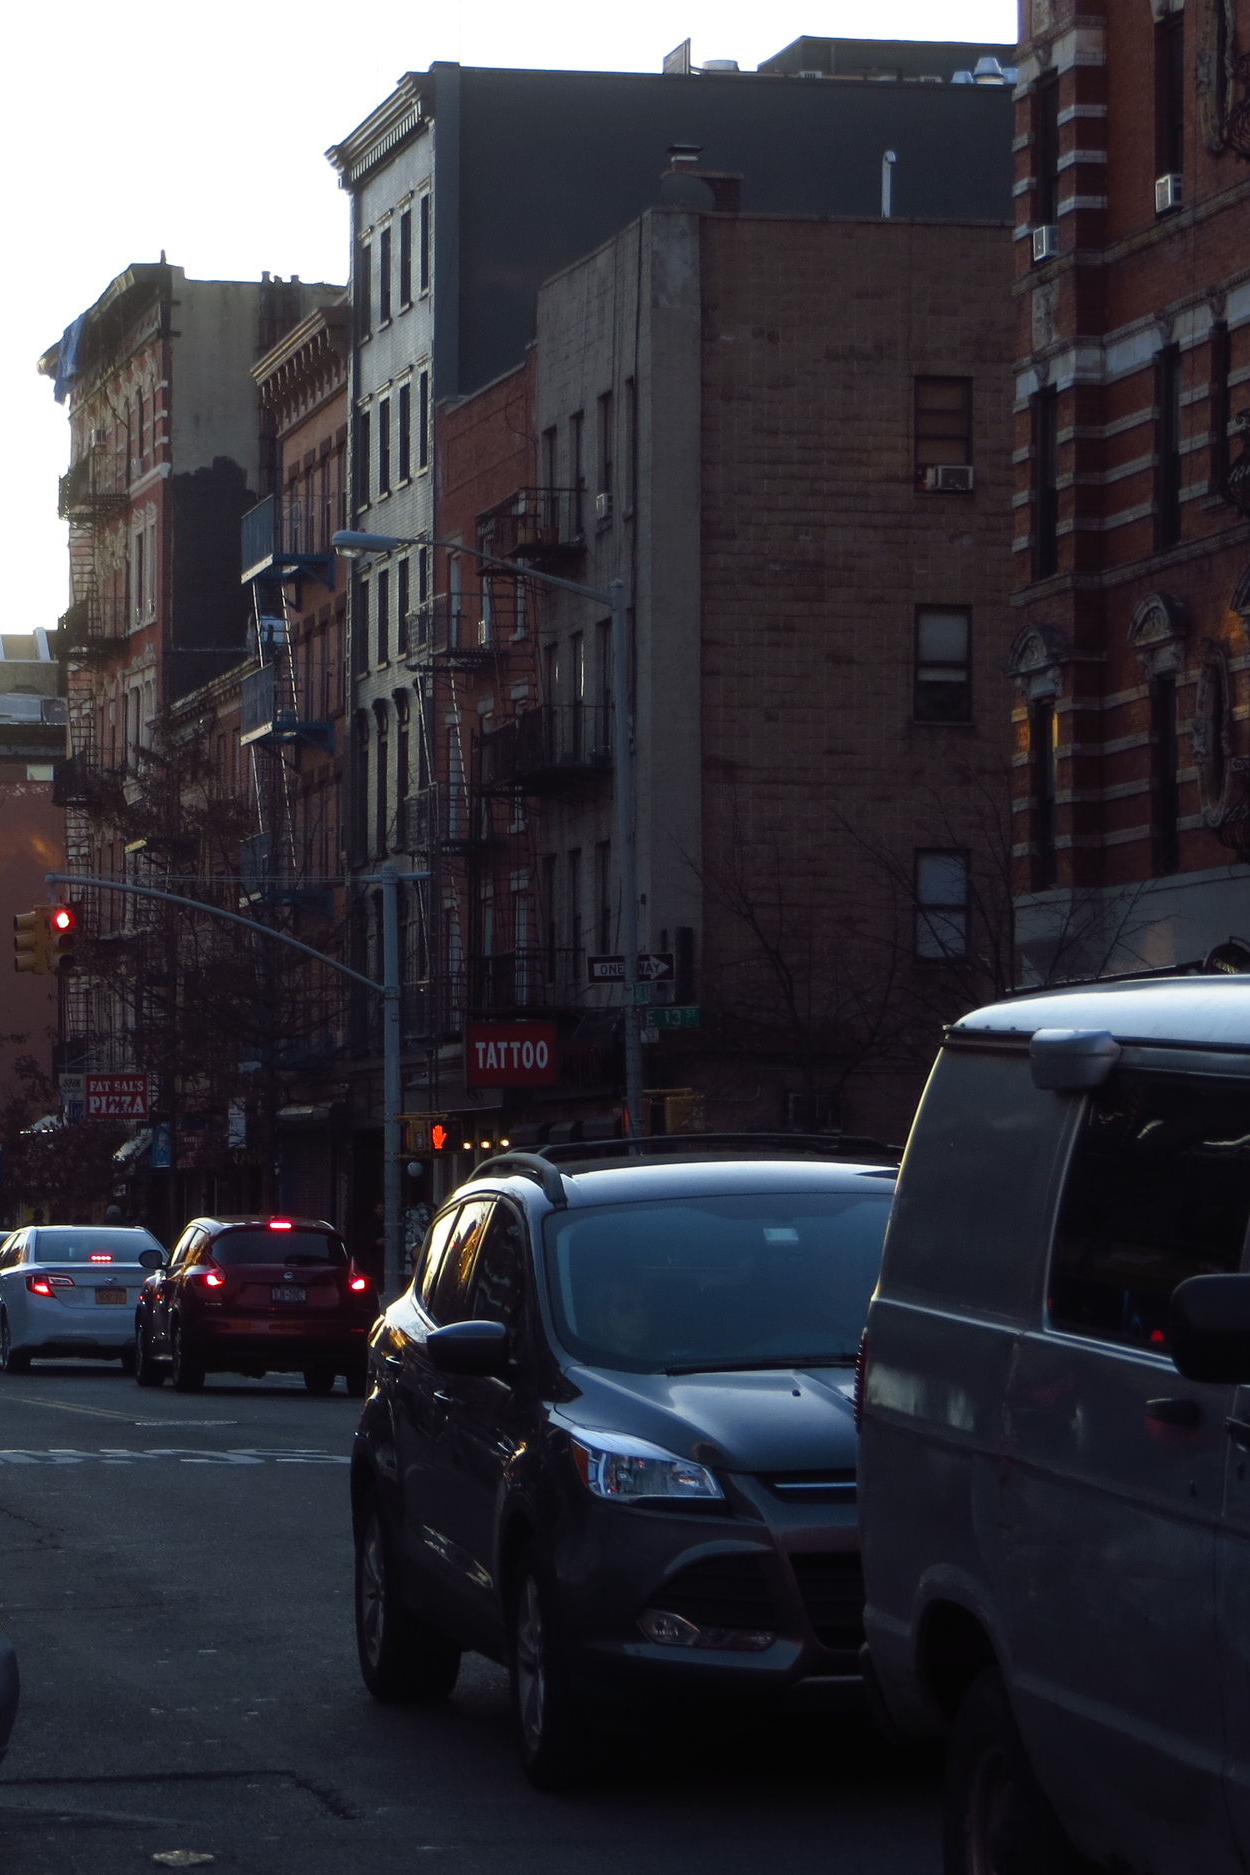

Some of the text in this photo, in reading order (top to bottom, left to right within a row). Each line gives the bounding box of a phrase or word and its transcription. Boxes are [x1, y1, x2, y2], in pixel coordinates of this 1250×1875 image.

[600, 963, 625, 975] ONE
[665, 1009, 682, 1026] 13
[686, 1008, 696, 1018] ST
[475, 1040, 549, 1069] TATTOO
[89, 1080, 145, 1092] FAT SAL'S
[88, 1096, 145, 1114] PIZZA
